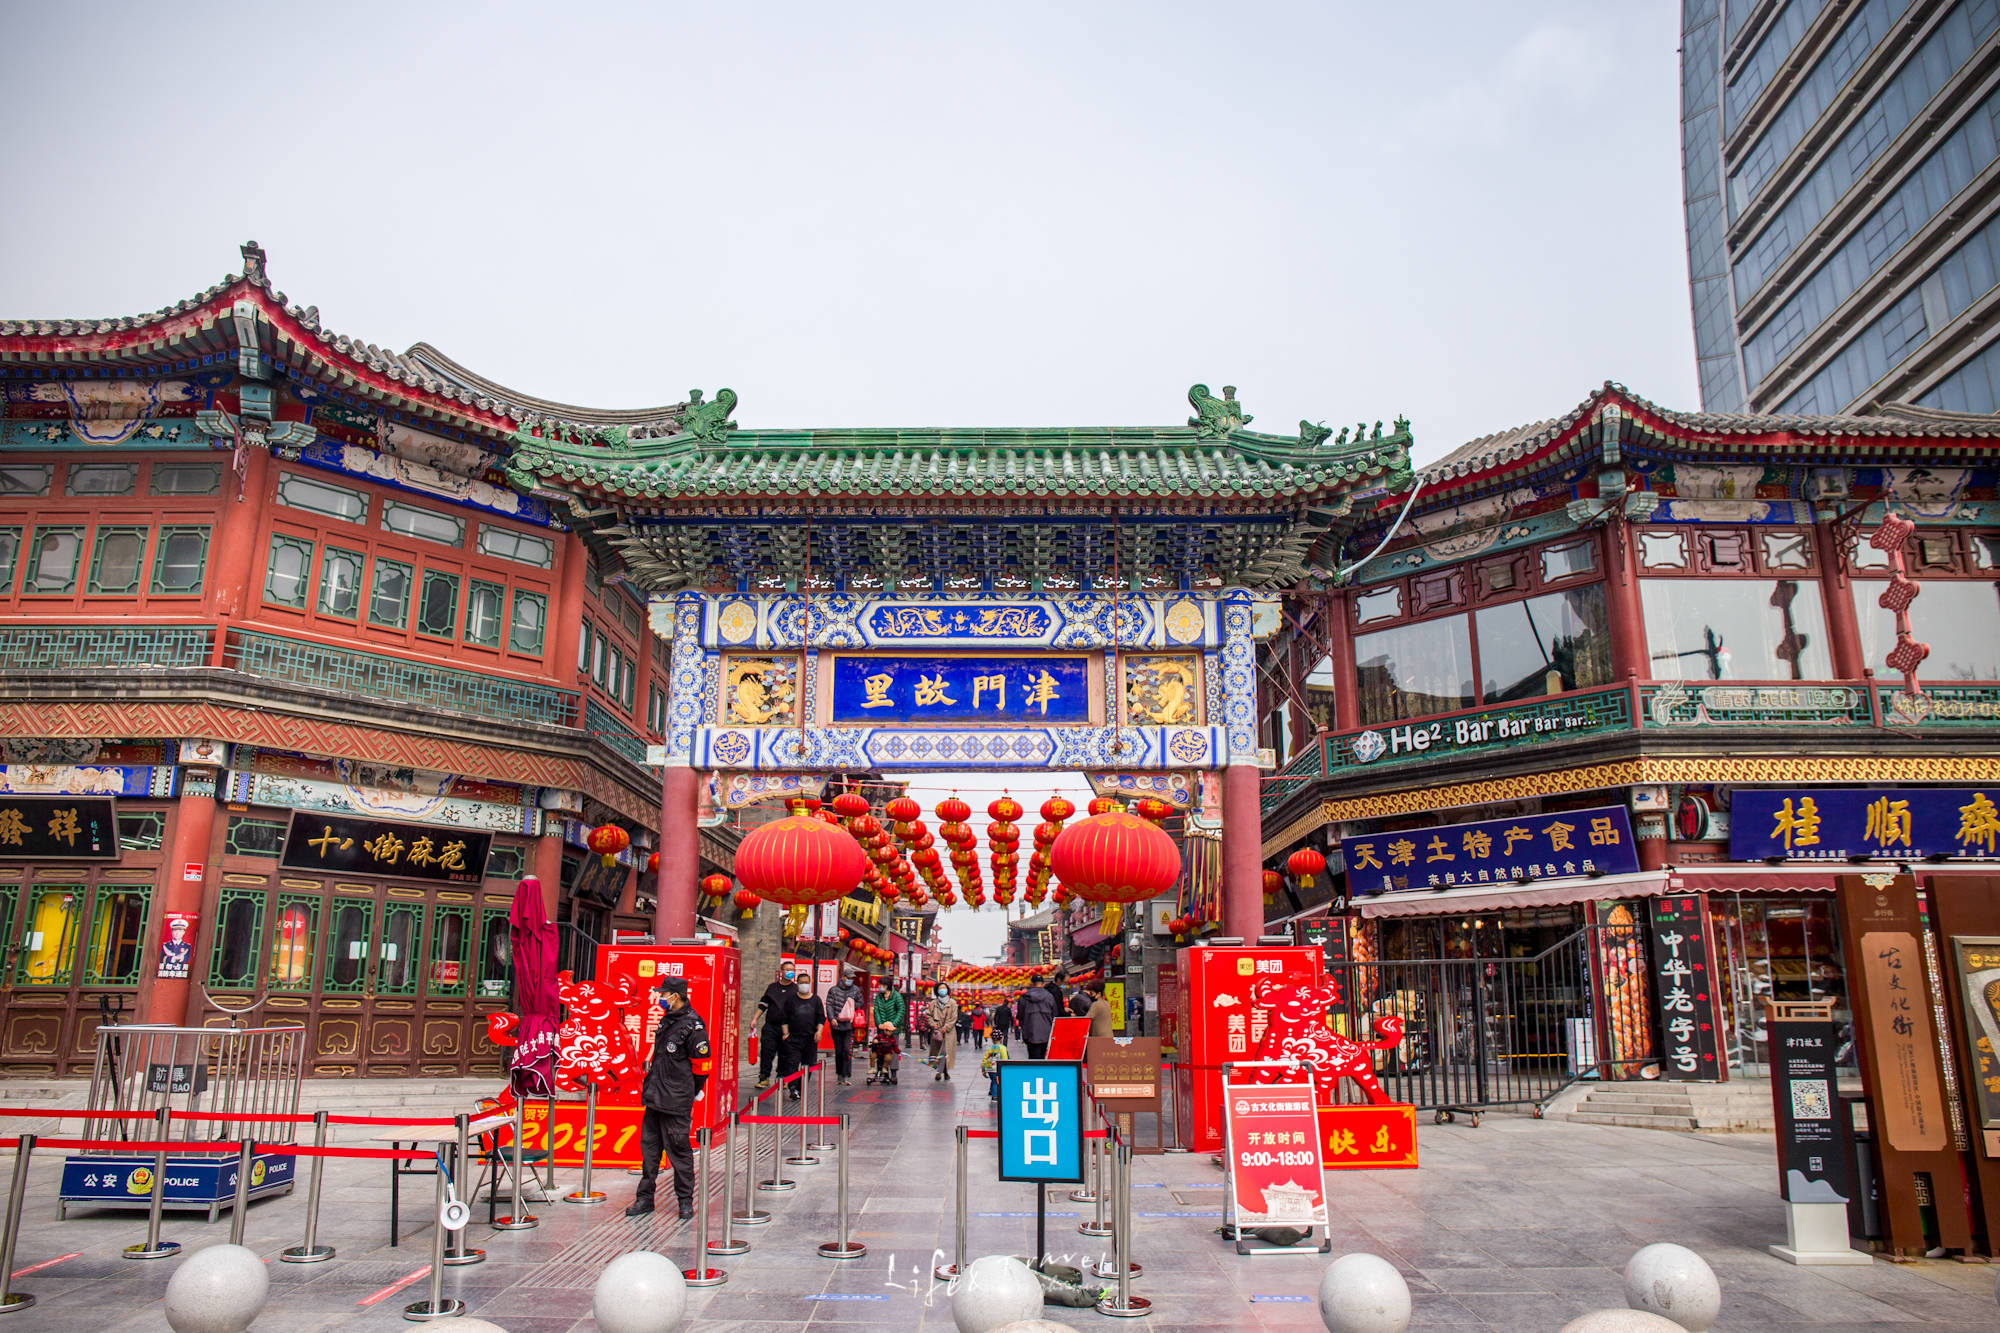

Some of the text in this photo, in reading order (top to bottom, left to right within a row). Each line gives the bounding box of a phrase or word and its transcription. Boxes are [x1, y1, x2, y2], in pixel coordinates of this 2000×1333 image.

[1758, 690, 1799, 707] BEER
[1455, 719, 1494, 745] Bar
[1498, 718, 1531, 739] Bar
[1535, 716, 1561, 732] Bar
[307, 825, 467, 871] 十八街麻花
[1353, 816, 1621, 871] 天津土特产食品
[1427, 859, 1596, 887] 来自大自然的绿色食品
[657, 962, 684, 977] 美团
[1256, 960, 1283, 974] 美团
[1659, 930, 1699, 1073] 中华老字号
[1228, 1014, 1246, 1053] 美团
[155, 1066, 185, 1082] 防暴
[152, 1081, 190, 1092] FAN BAO
[1250, 1101, 1311, 1113] 古文化街旅游区
[1021, 1077, 1059, 1165] 出口
[506, 1121, 638, 1154] 2021
[1248, 1131, 1305, 1146] 开放时间
[1240, 1150, 1314, 1167] 9:00~18:00
[269, 1162, 288, 1174] POLICE
[83, 1173, 199, 1188] 公安 POLICE
